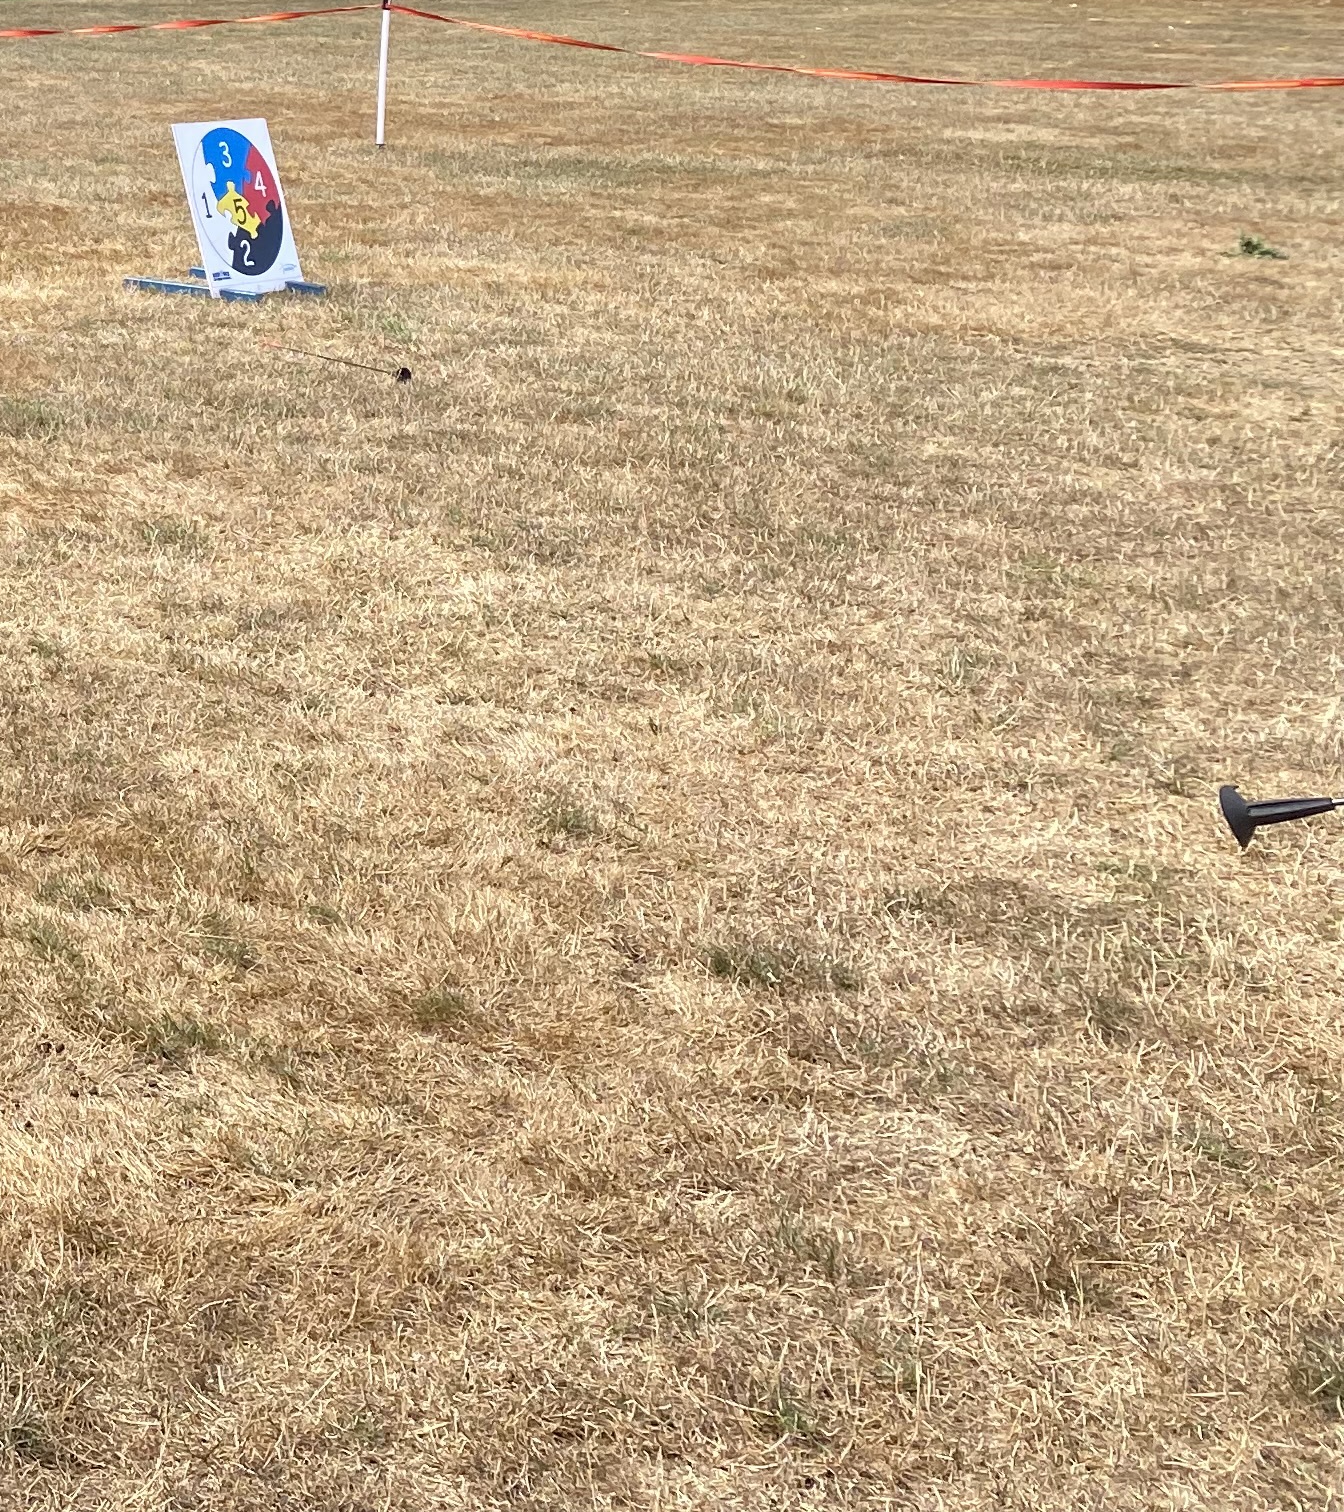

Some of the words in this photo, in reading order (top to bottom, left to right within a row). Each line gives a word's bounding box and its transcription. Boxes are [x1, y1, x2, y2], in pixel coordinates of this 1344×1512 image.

[219, 141, 232, 167] 3
[254, 171, 267, 197] 4
[201, 192, 212, 218] 1
[233, 198, 247, 225] 5
[240, 239, 255, 267] 2
